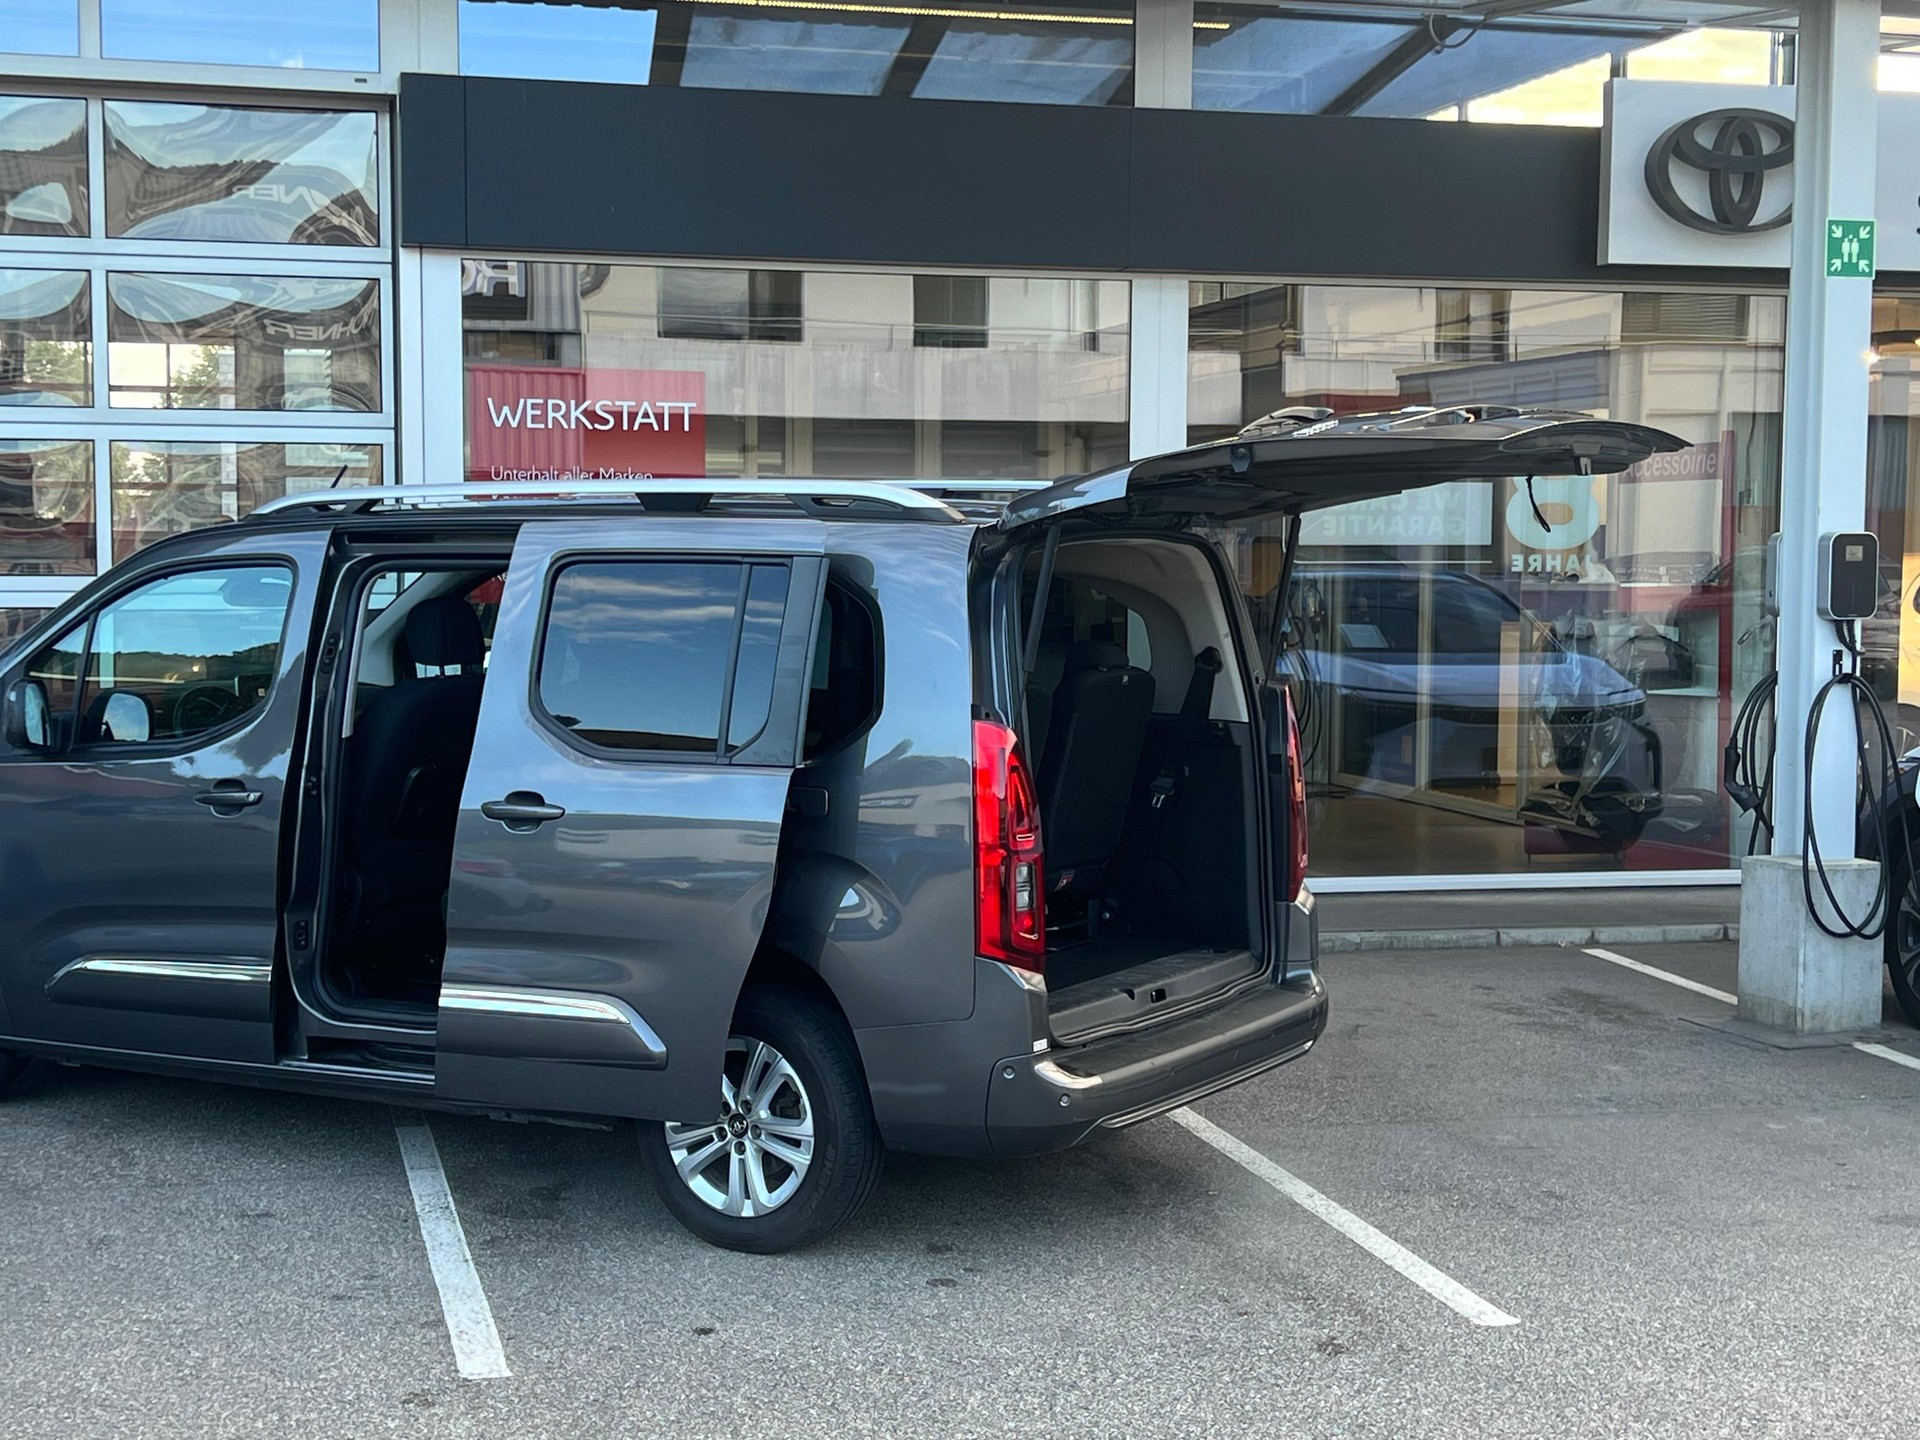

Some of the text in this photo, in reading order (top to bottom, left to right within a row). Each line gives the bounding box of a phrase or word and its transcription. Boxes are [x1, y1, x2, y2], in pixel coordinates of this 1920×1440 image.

[487, 397, 697, 432] WERKSTATT
[490, 465, 653, 481] Unterhalt aller Marken
